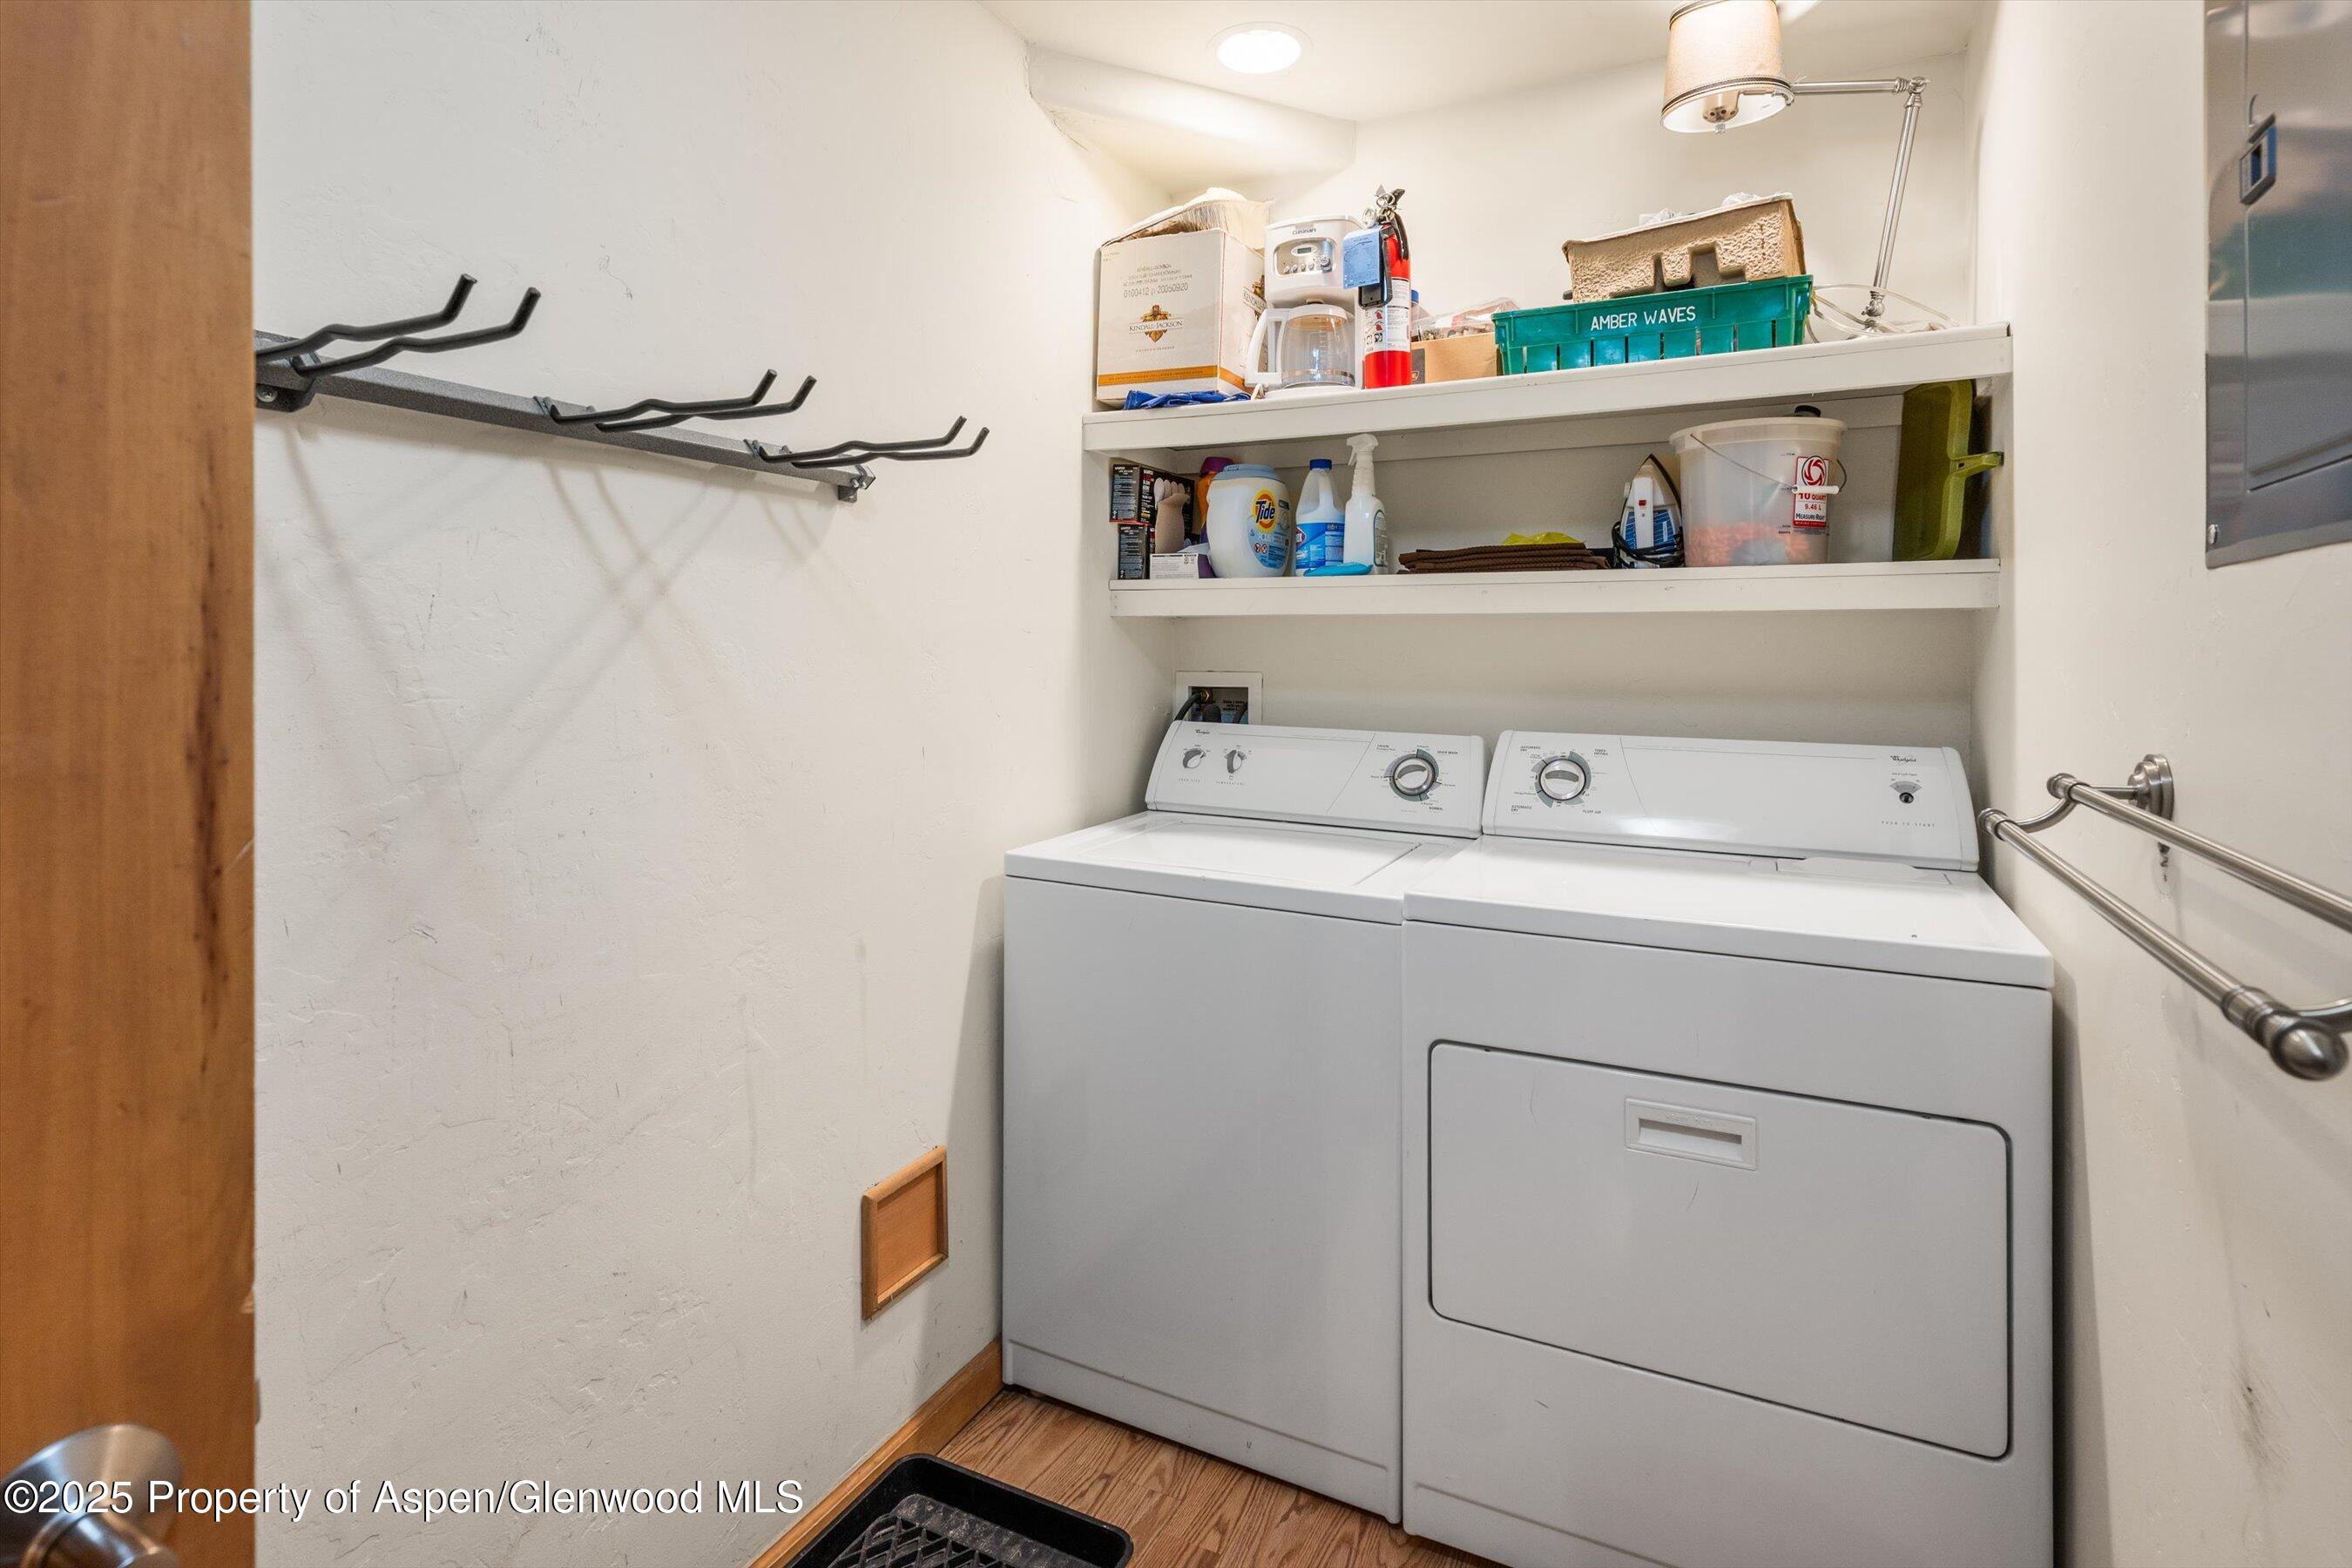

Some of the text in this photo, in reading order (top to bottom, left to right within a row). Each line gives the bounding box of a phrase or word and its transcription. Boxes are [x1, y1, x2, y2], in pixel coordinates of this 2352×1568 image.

[1591, 306, 1696, 331] AMBER WAVES
[1255, 500, 1275, 523] Tide
